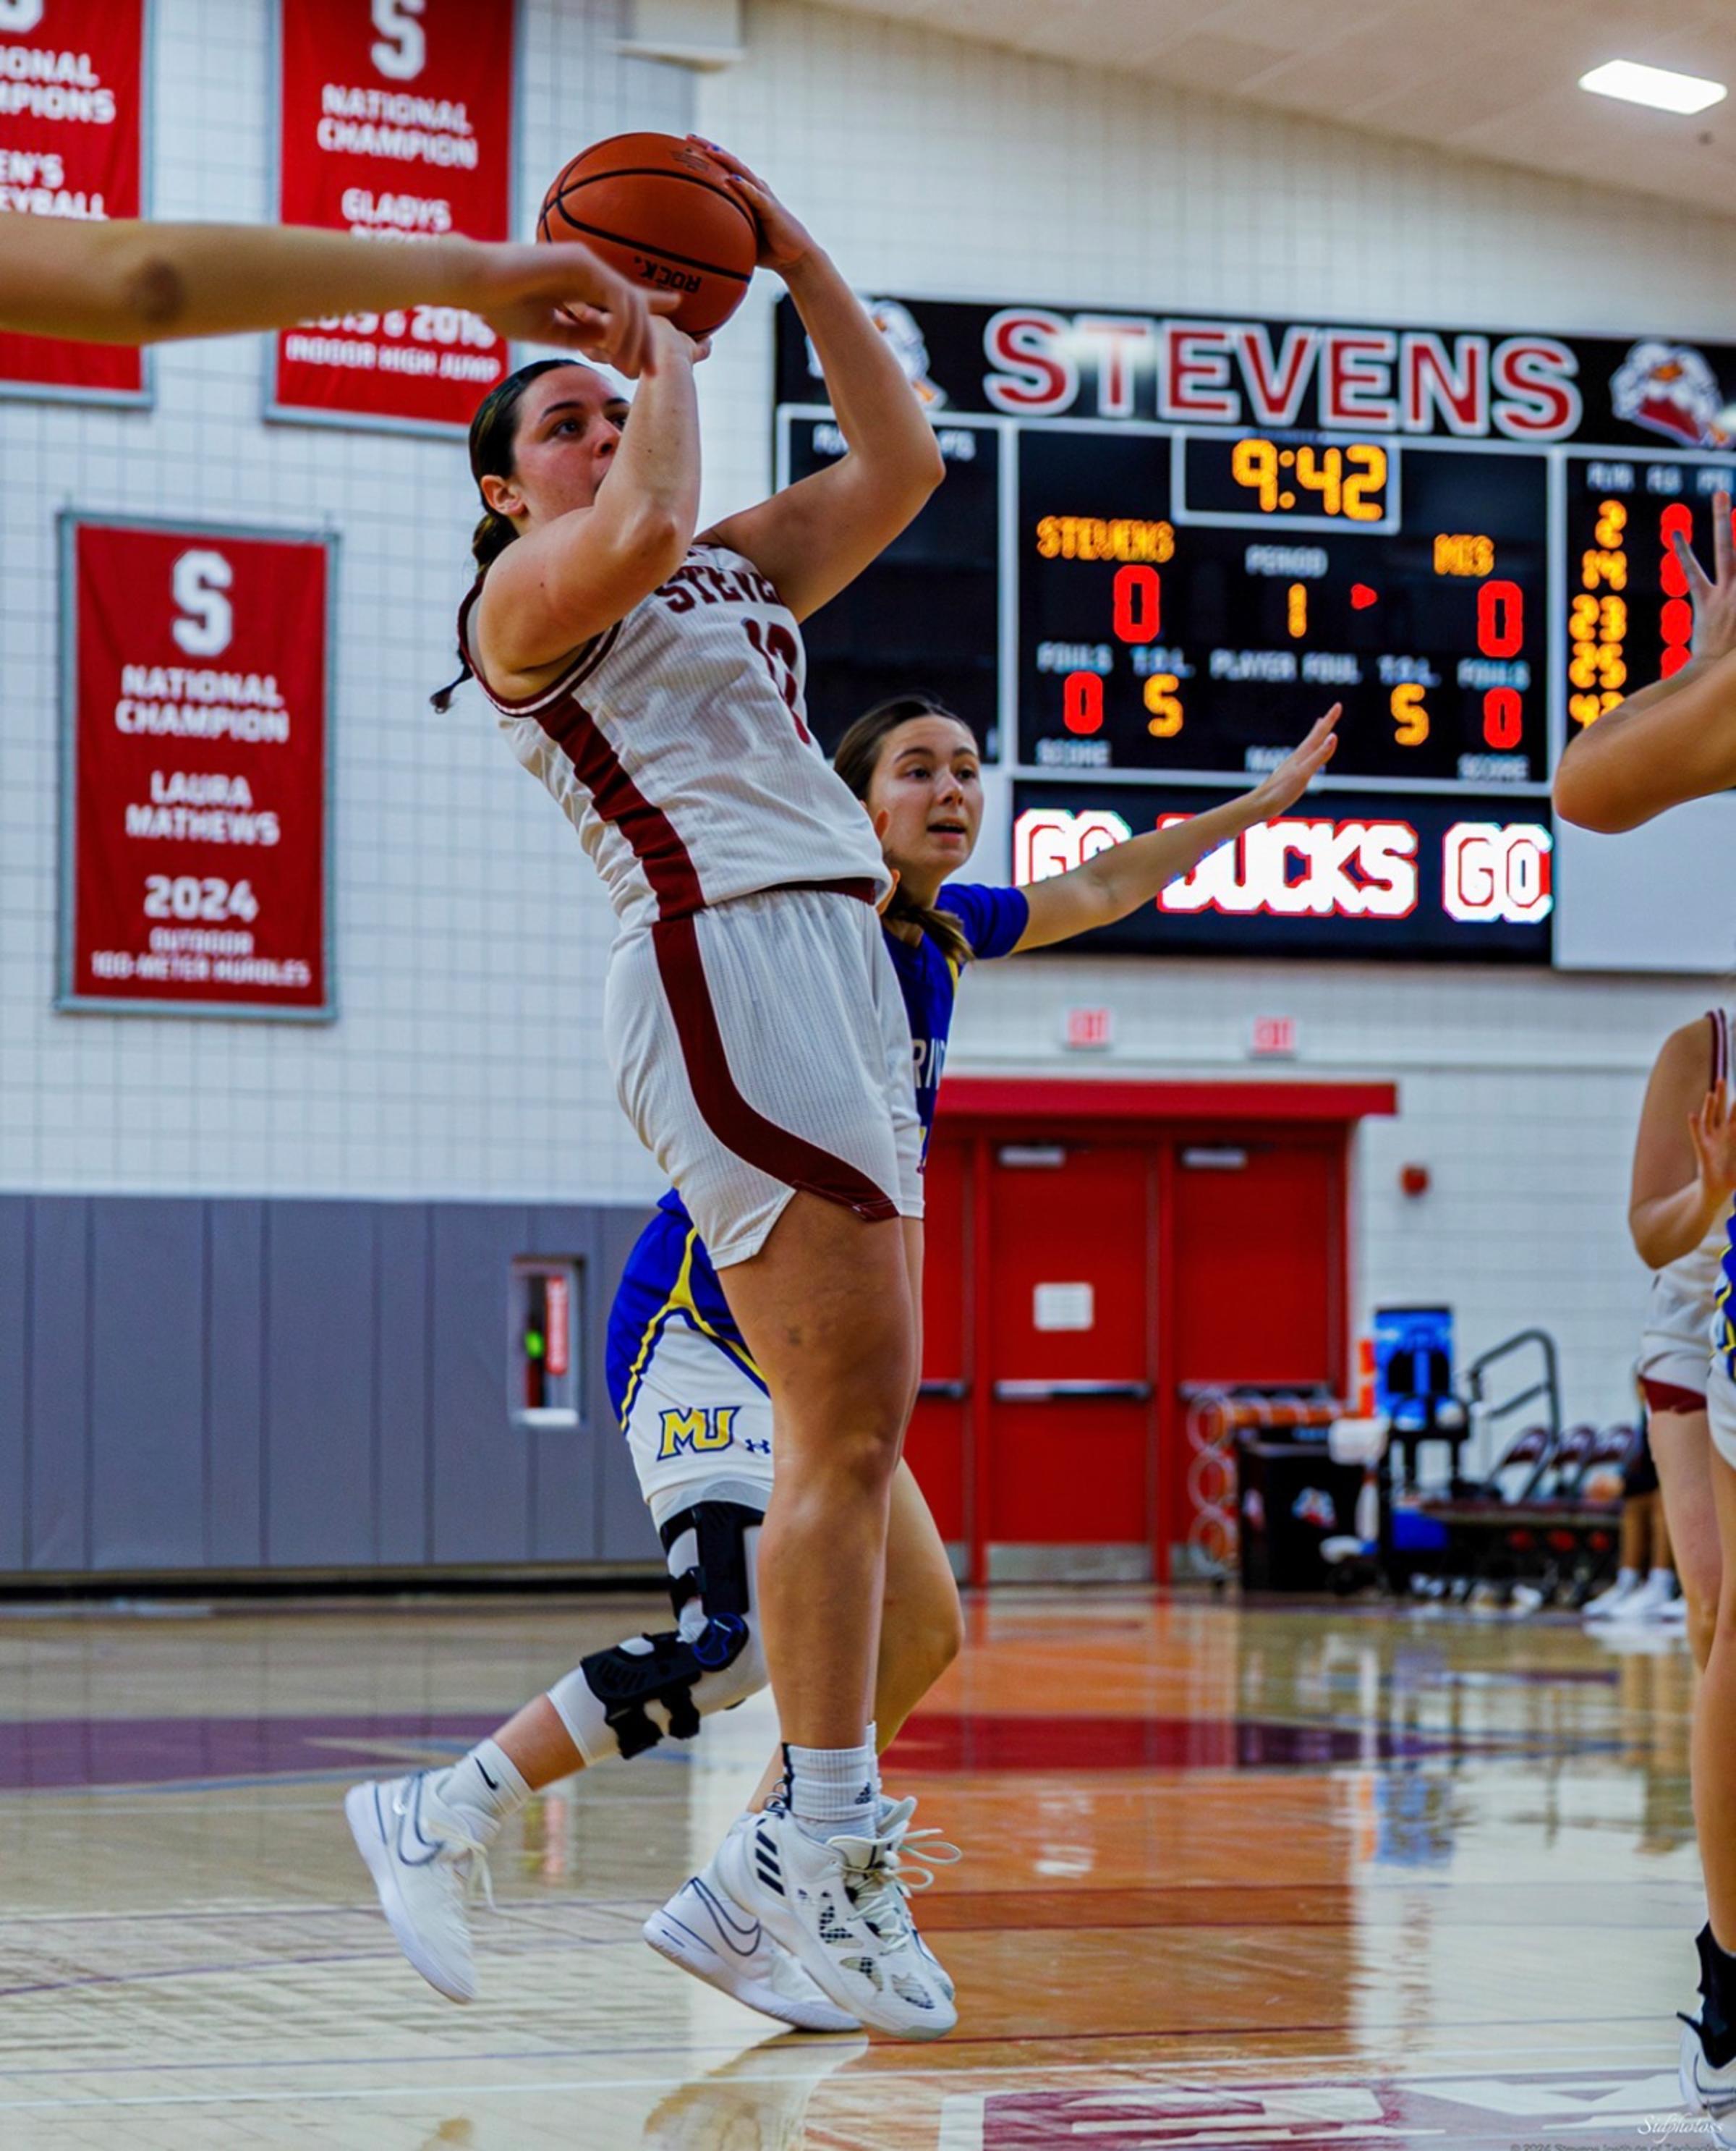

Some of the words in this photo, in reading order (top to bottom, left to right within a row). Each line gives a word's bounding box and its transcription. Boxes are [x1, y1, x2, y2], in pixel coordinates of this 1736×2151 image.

[371, 0, 425, 81] S
[322, 83, 473, 135] NATIONAL
[318, 117, 478, 170] CHAMPION
[341, 187, 452, 232] GLADYS
[439, 352, 501, 383] JUMP
[982, 308, 1583, 441] STEVENS
[1232, 439, 1387, 521] 9:42
[1595, 500, 1627, 548] 2
[1245, 544, 1328, 578] PERIOD
[172, 550, 233, 656] S
[1114, 564, 1160, 643] 0
[1288, 583, 1307, 637] 1
[1477, 580, 1523, 658] 0
[122, 663, 284, 708] NATIONAL
[1209, 649, 1298, 682] PLAYER
[115, 698, 290, 744] CHAMPION
[1063, 671, 1103, 734] 0
[1144, 674, 1183, 737] 5
[1390, 683, 1429, 746] 5
[1484, 687, 1522, 749] 0
[150, 770, 253, 810] LAURA
[125, 803, 281, 847] MATHEWS
[143, 874, 259, 922] 2024
[1443, 821, 1554, 924] GO
[657, 1406, 743, 1461] MU
